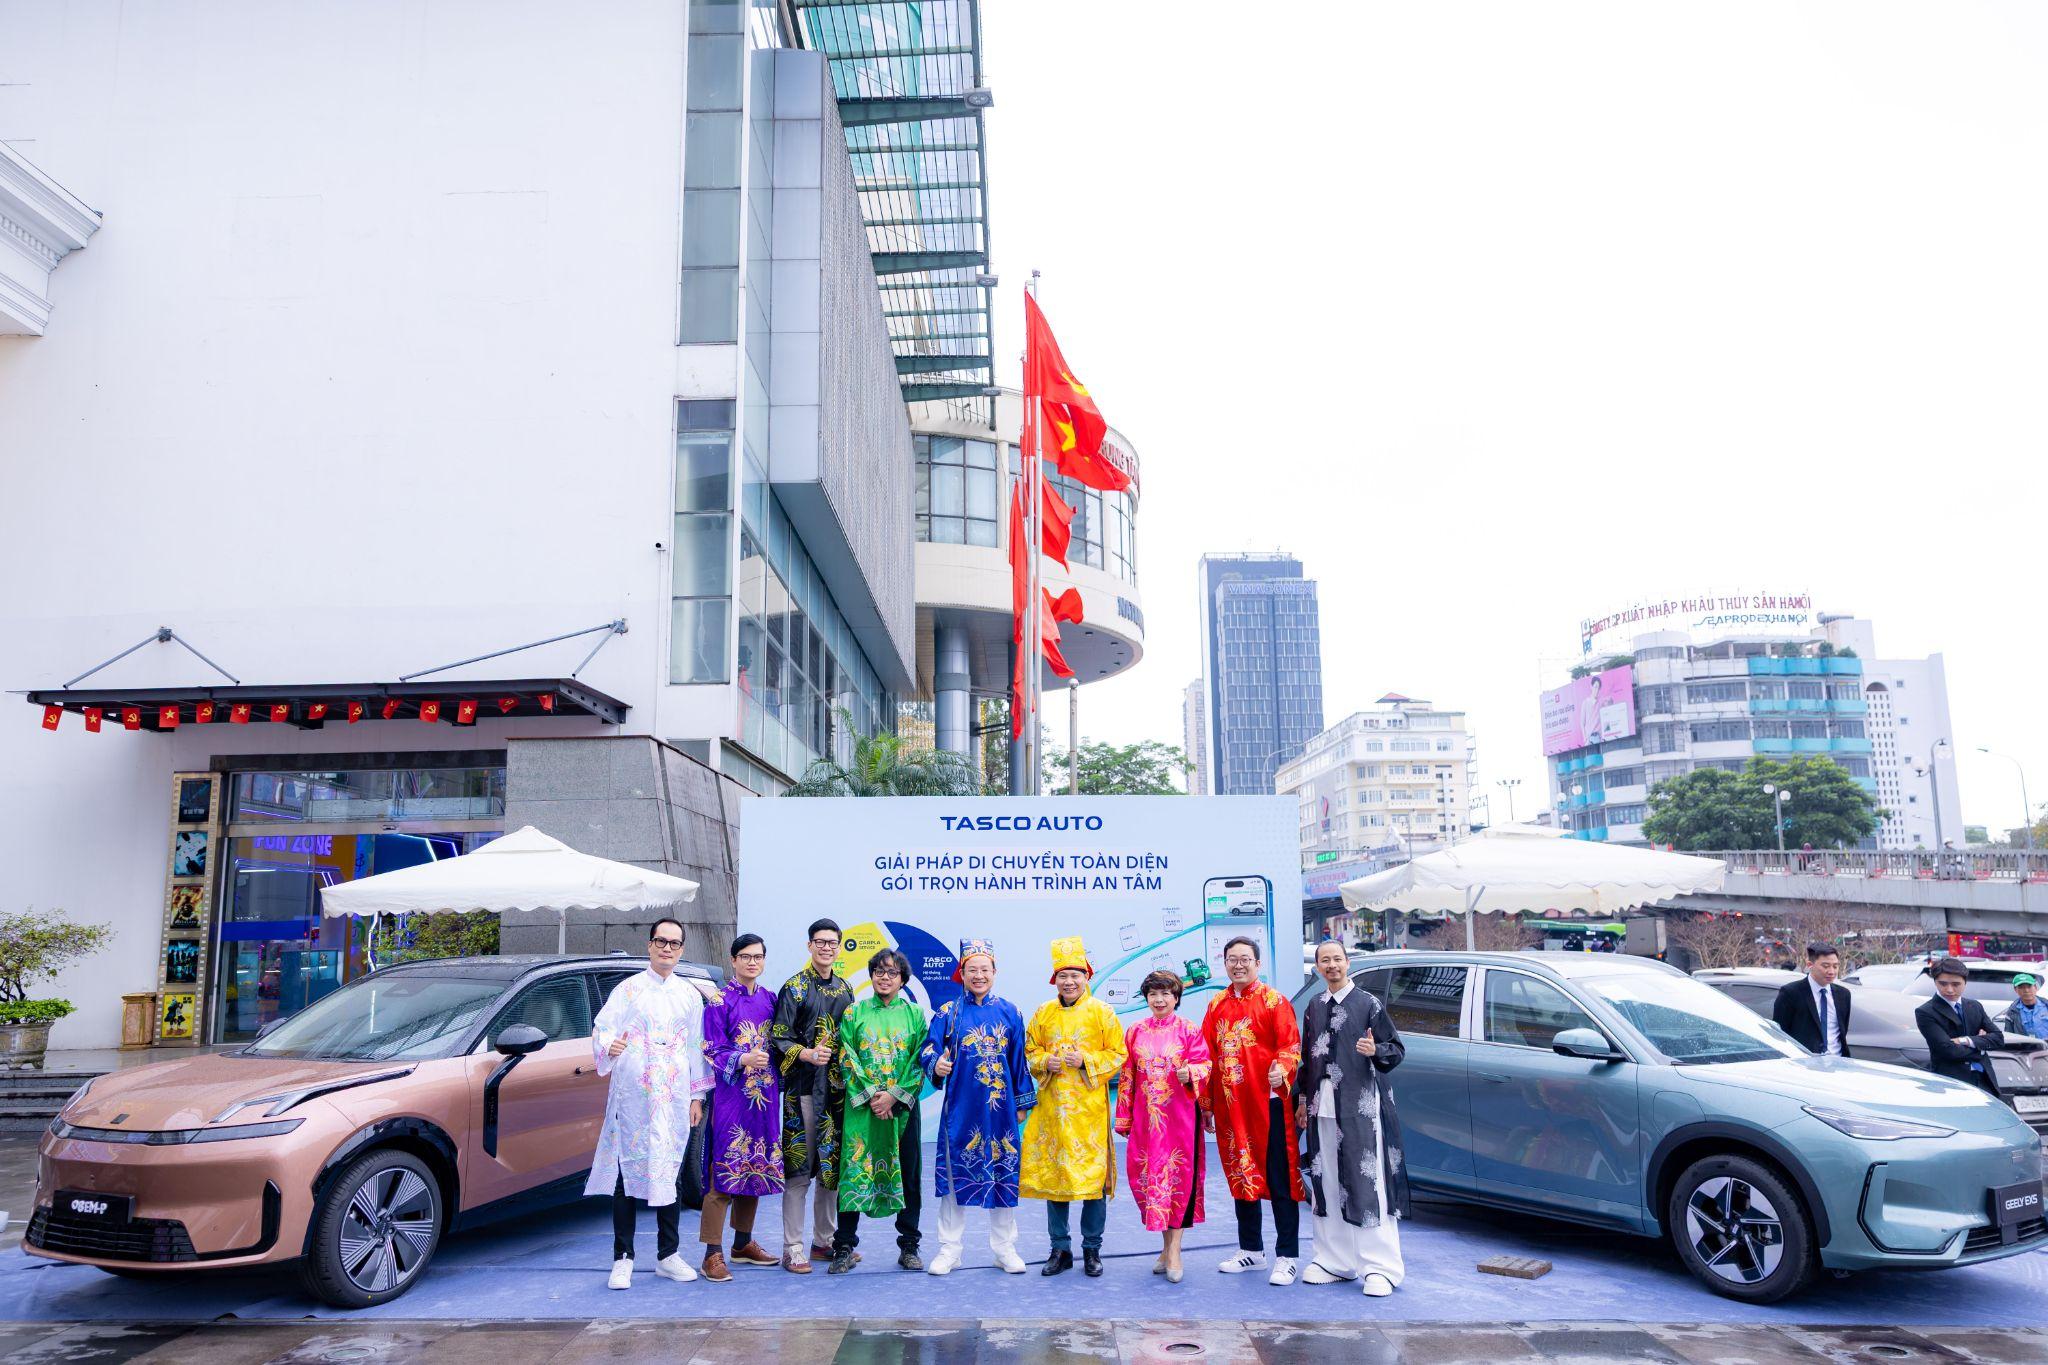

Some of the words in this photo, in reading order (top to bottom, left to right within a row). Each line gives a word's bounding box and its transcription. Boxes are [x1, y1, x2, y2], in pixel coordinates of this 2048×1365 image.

[1227, 583, 1313, 595] VINACONEX
[1647, 599, 1678, 619] NHẬP
[940, 816, 1031, 831] TASCO
[1036, 816, 1103, 831] AUTO
[254, 835, 287, 851] FUN
[290, 835, 334, 856] ZONE
[875, 851, 910, 870] GIẢI
[916, 852, 963, 870] PHÁP
[969, 855, 986, 870] DI
[991, 850, 1065, 870] CHUYỂN
[1070, 852, 1121, 870] TOÀN
[1126, 851, 1169, 872] DIỆN
[881, 873, 913, 891] GÓI
[919, 876, 969, 894] TRỌN
[974, 873, 1027, 891] HÀNH
[1032, 873, 1087, 891] TRÌNH
[1092, 876, 1118, 890] AN
[1123, 873, 1162, 890] TÂM
[2005, 1196, 2024, 1211] GEELY
